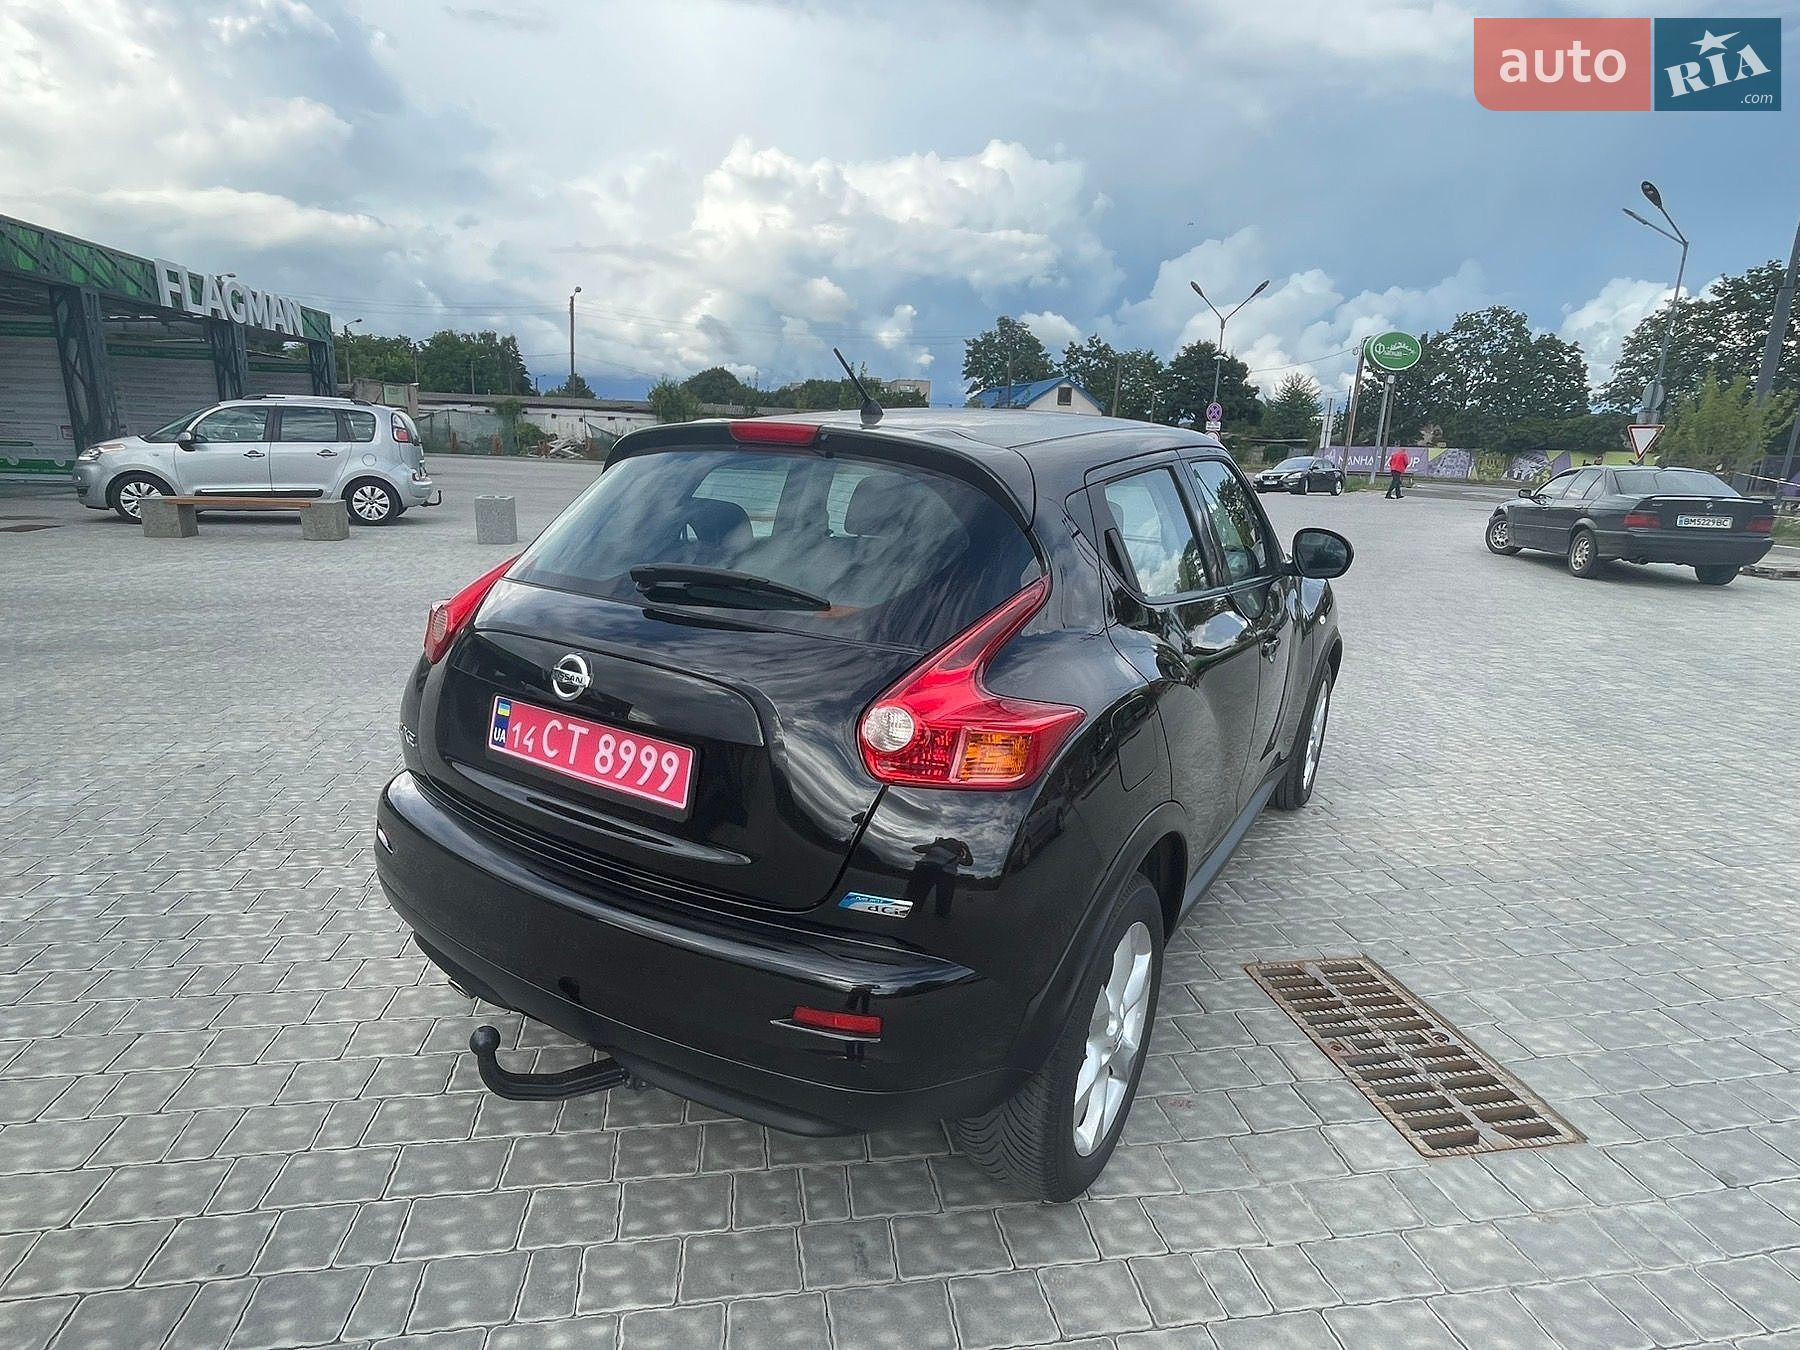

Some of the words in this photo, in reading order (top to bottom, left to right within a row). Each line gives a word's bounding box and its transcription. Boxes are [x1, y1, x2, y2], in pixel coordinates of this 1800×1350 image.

[154, 257, 304, 337] FLAGMAN
[493, 726, 506, 744] UA
[594, 733, 680, 793] 8999
